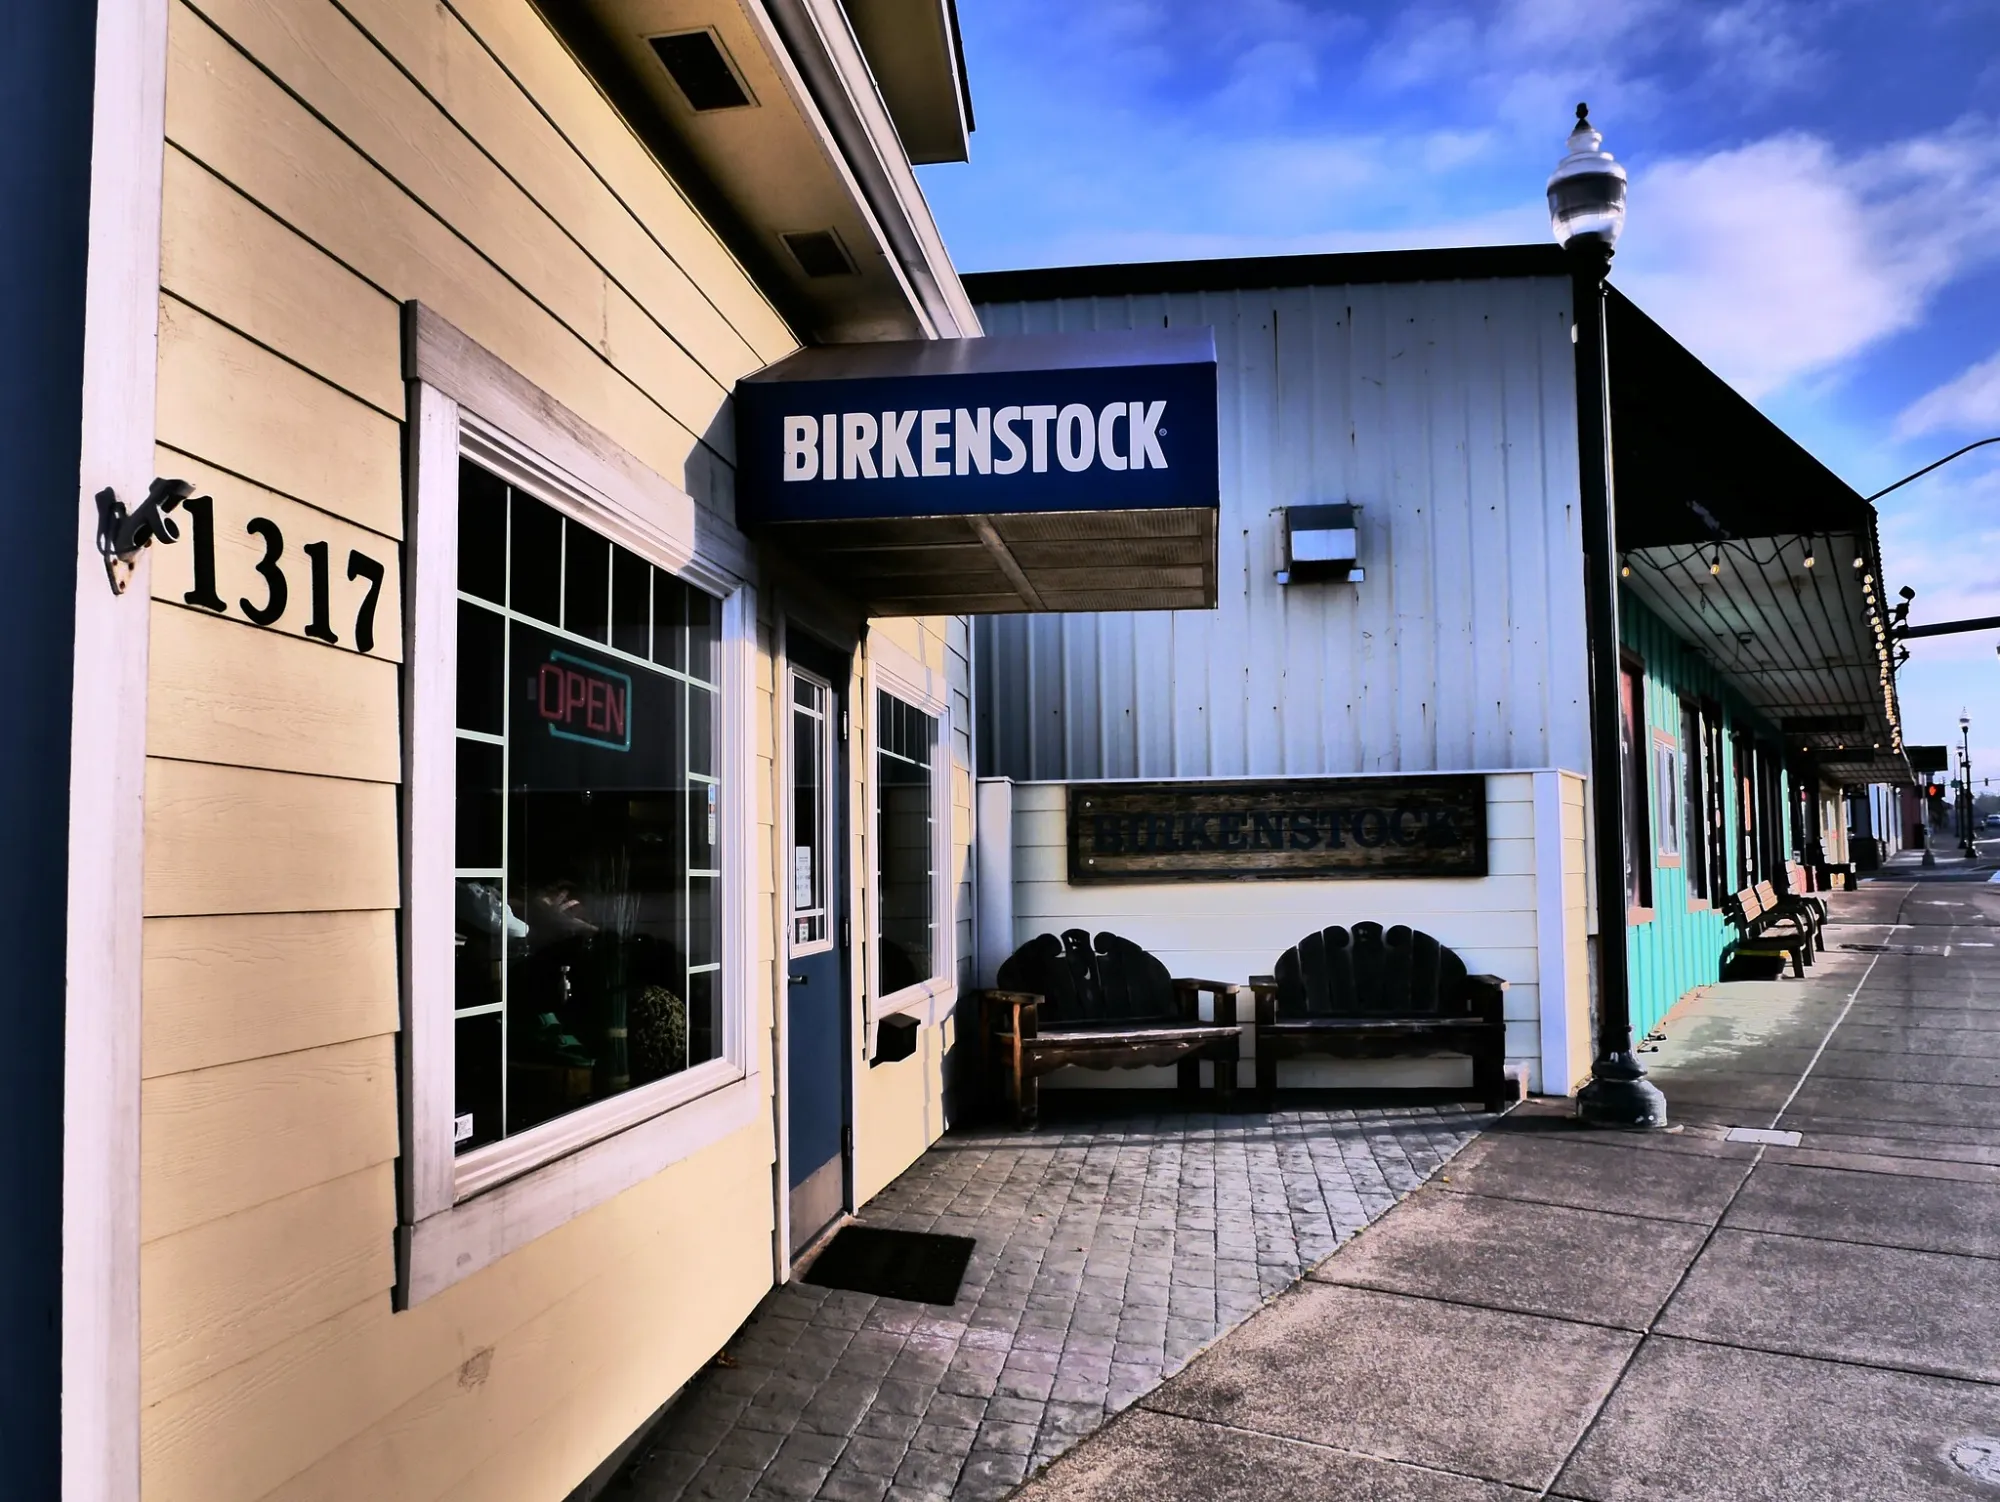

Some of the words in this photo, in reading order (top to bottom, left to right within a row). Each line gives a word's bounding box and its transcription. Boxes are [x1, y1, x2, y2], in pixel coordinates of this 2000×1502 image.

[182, 495, 385, 653] 1317
[539, 663, 625, 737] OPEN
[1093, 806, 1462, 852] BIRKENSTOCK
